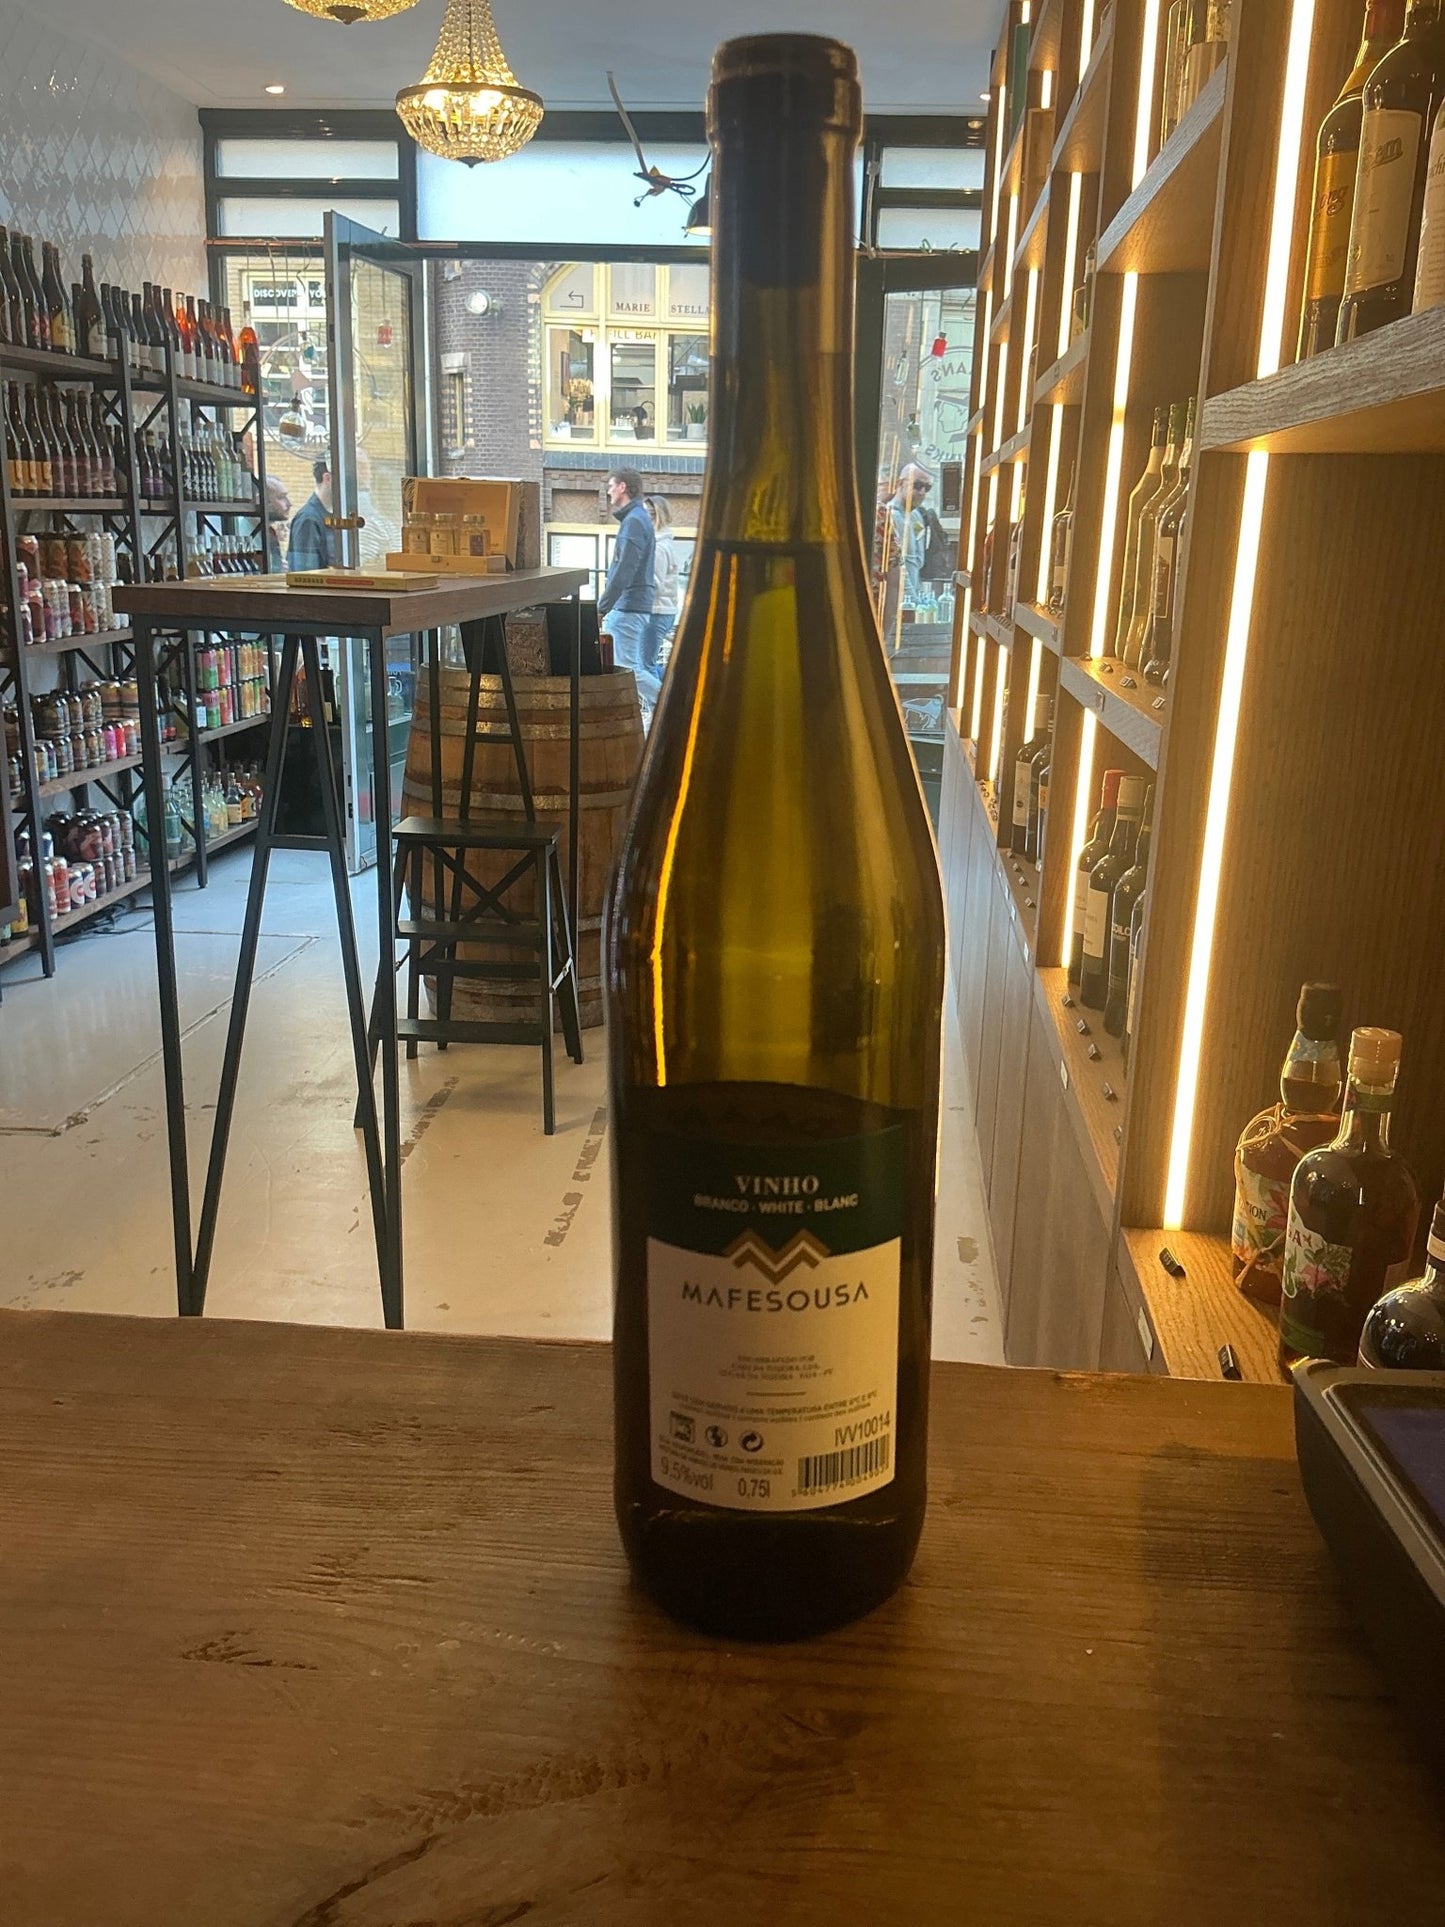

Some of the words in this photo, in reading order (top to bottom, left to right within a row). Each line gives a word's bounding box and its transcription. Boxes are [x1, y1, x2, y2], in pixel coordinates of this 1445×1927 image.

[615, 301, 651, 312] MARIE
[733, 1173, 820, 1195] VINHO
[693, 1193, 750, 1212] BRANCO
[758, 1199, 804, 1215] WHITE
[813, 1192, 859, 1213] BLANC
[681, 1280, 870, 1312] MAFESOUSA
[834, 1410, 891, 1447] IVV10014
